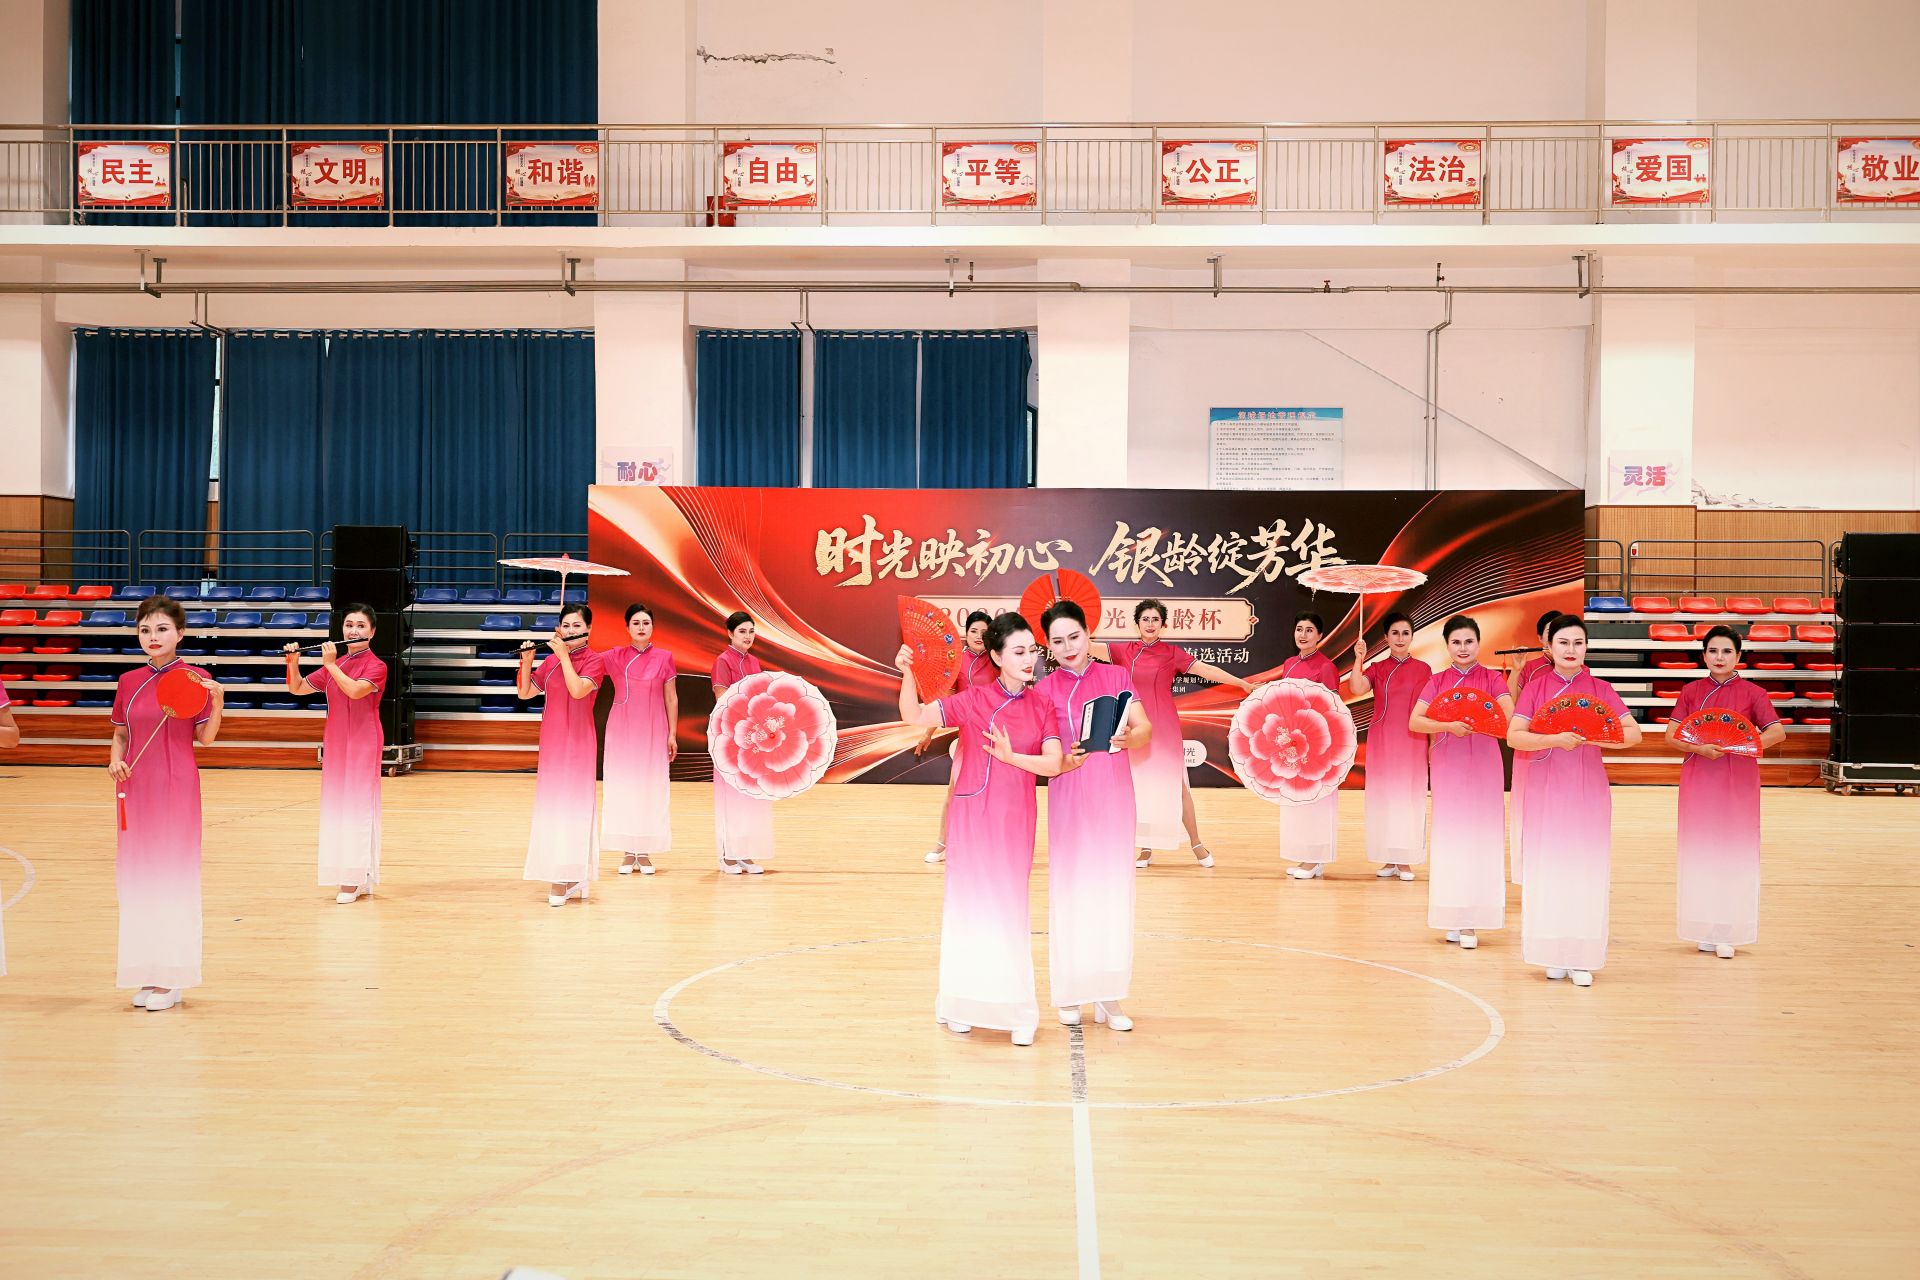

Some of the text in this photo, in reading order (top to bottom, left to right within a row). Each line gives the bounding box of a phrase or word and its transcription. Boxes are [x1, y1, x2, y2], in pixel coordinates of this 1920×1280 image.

[102, 159, 153, 184] 民主
[314, 158, 366, 185] 文明
[528, 158, 584, 185] 和谐
[750, 157, 797, 184] 自由
[965, 158, 1021, 185] 平等
[1186, 158, 1241, 184] 公正
[1409, 156, 1465, 182] 法治
[1636, 155, 1692, 182] 爱国
[1862, 154, 1919, 181] 敬业
[617, 461, 657, 481] 耐心
[1624, 465, 1666, 486] 灵活
[815, 514, 1354, 595] 时光映初心 银龄绽芳华
